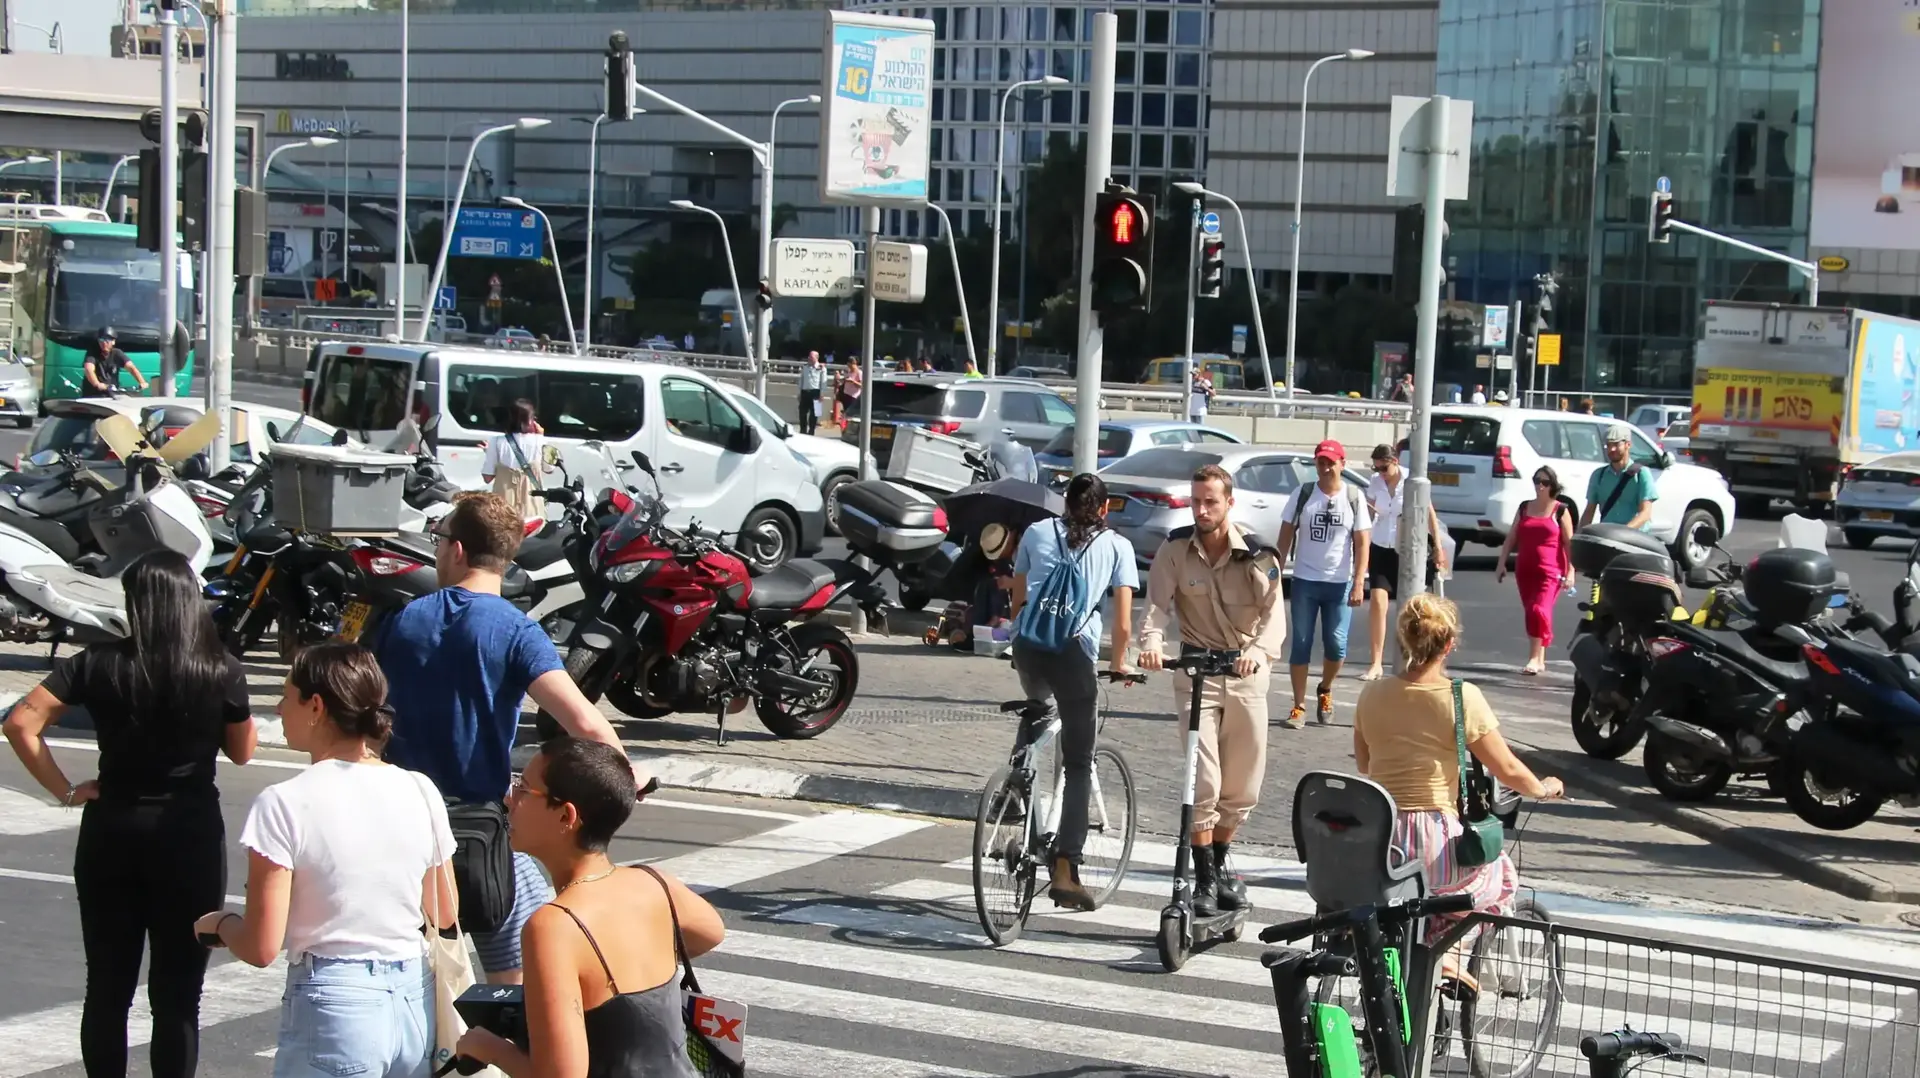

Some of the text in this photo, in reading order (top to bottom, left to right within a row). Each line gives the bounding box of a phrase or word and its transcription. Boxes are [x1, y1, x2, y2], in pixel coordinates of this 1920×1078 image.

[884, 60, 925, 77] הקולנוע
[878, 74, 924, 90] הישראלי
[293, 118, 360, 133] McDonal
[493, 211, 512, 219] מרכז
[785, 245, 808, 260] קפלן
[812, 251, 832, 259] אליעזר
[784, 279, 829, 289] KAPLAN
